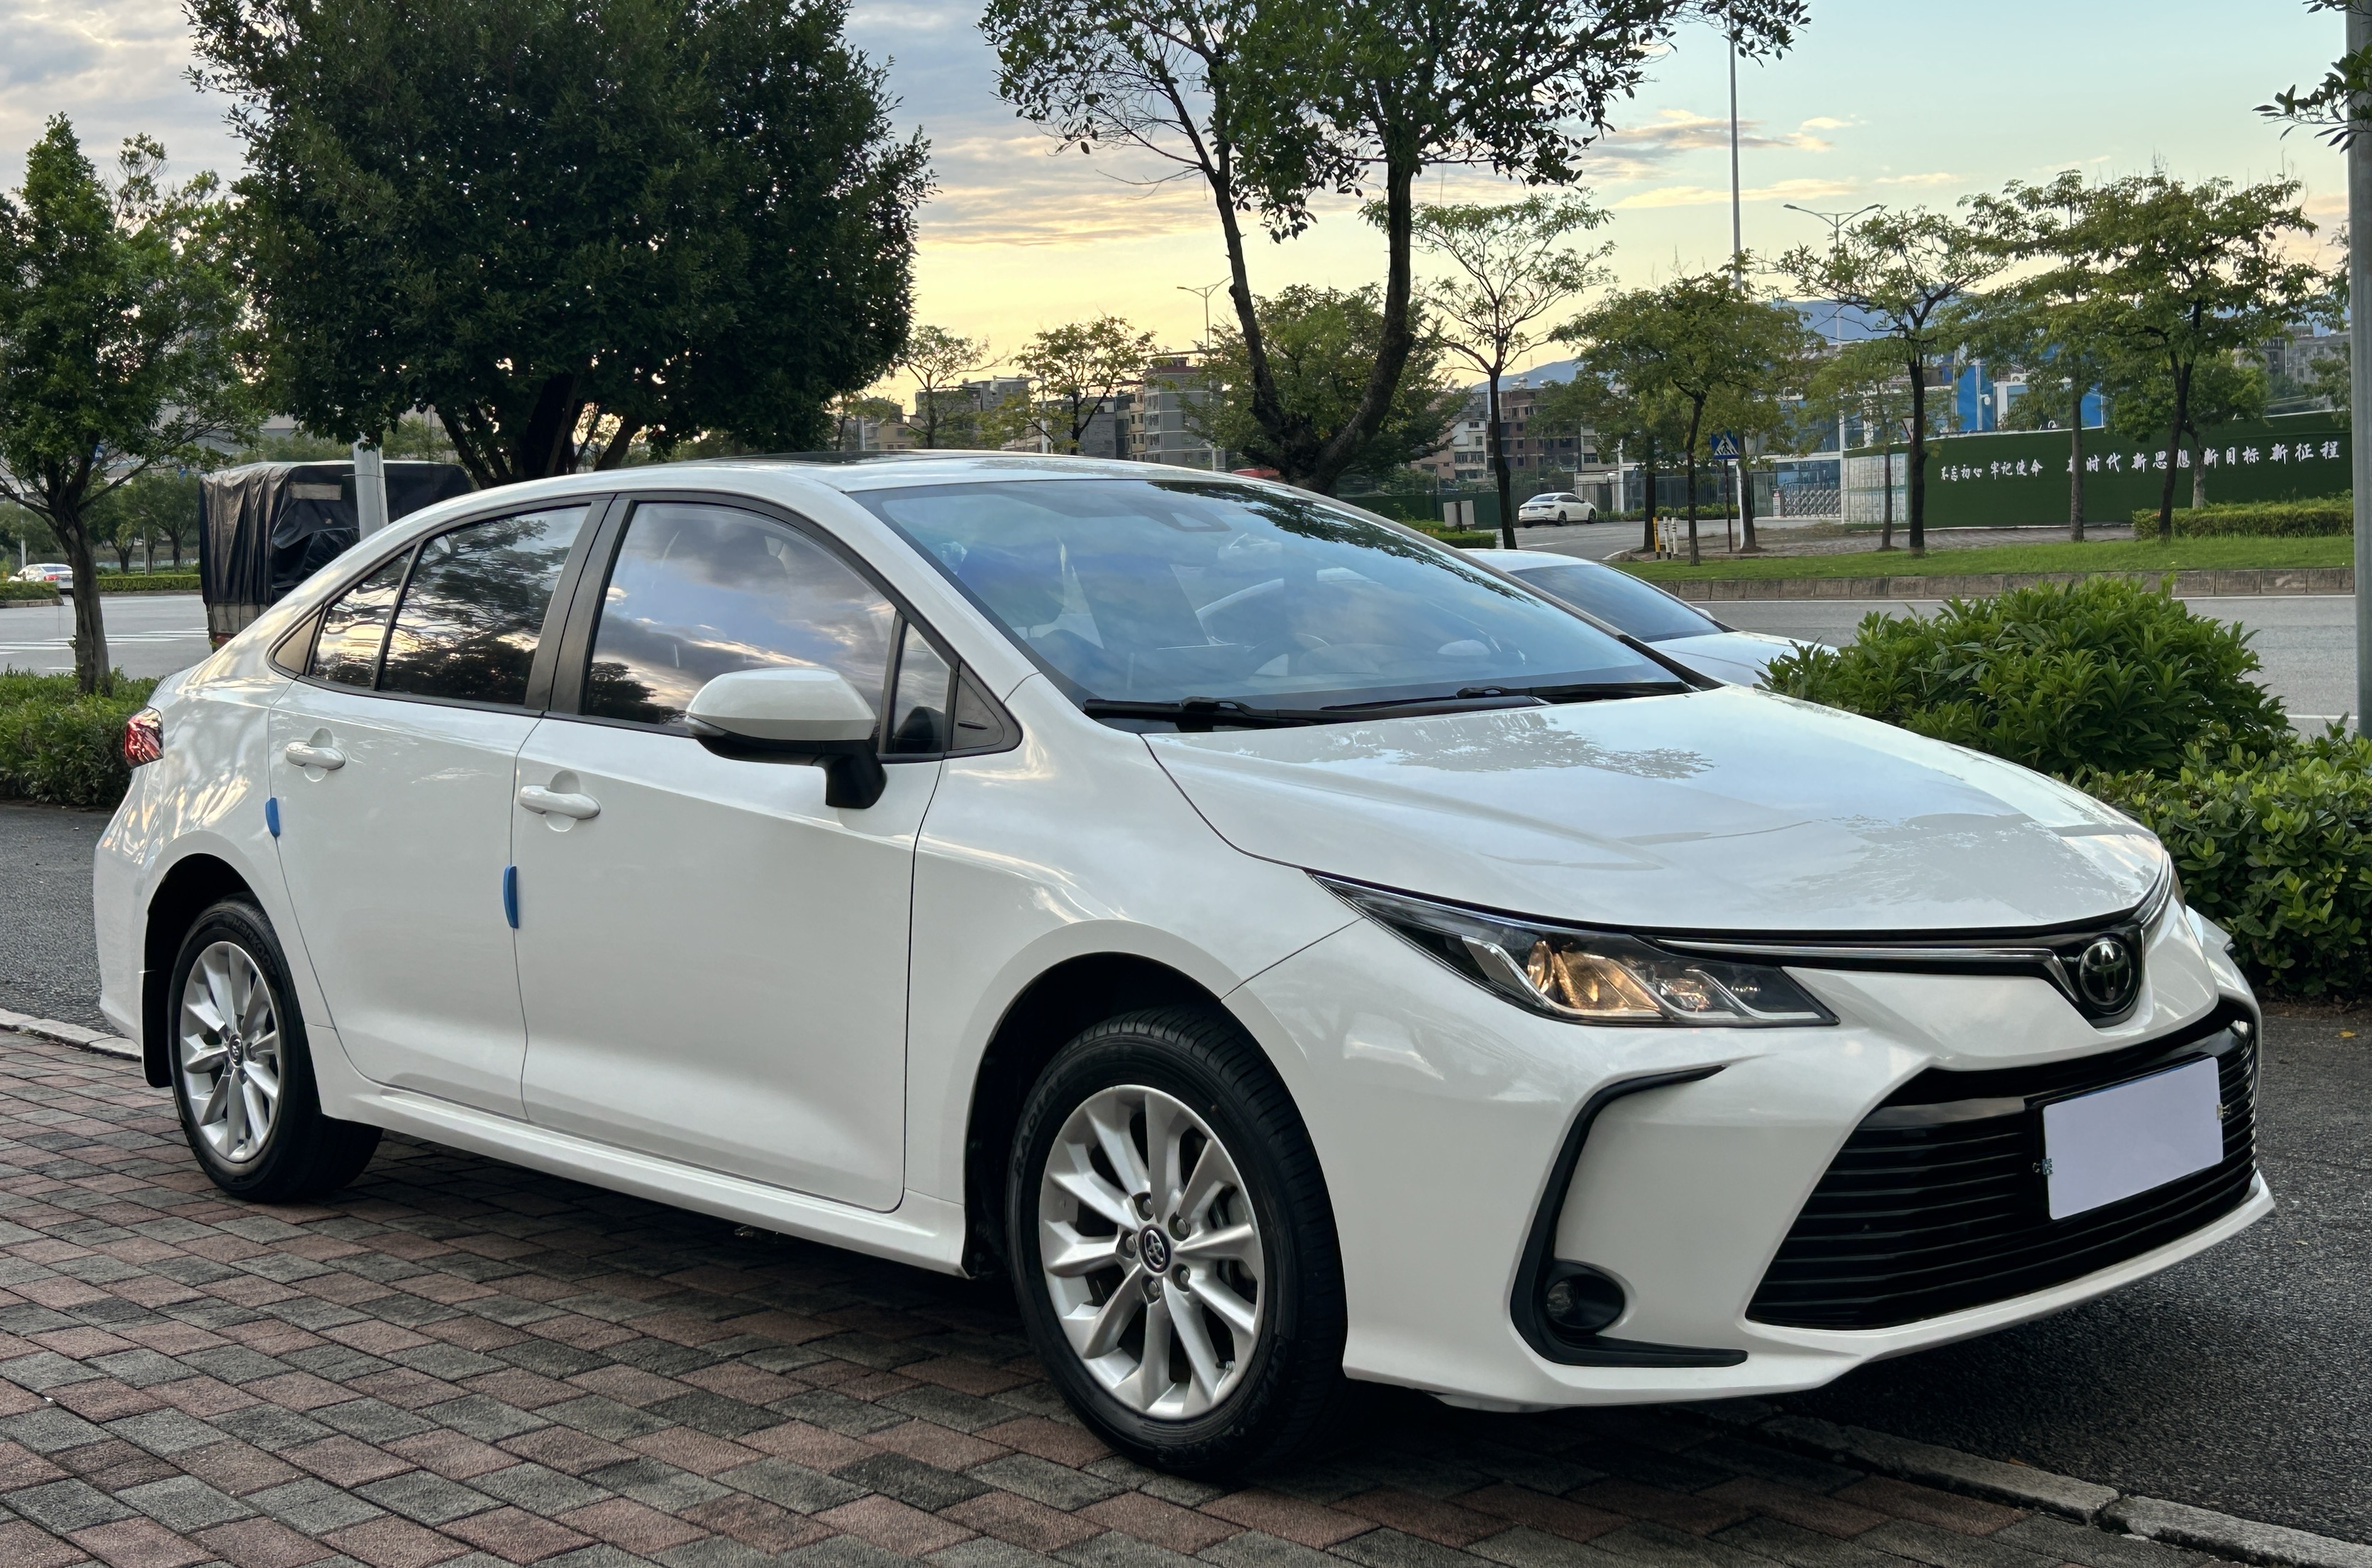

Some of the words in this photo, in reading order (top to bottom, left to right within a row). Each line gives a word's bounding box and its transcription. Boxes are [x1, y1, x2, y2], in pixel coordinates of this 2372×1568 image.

[1941, 464, 1983, 482] 不忘初心
[1990, 459, 2043, 479] 牢记使命
[2203, 445, 2260, 469] 新目标
[2269, 440, 2340, 465] 新征程
